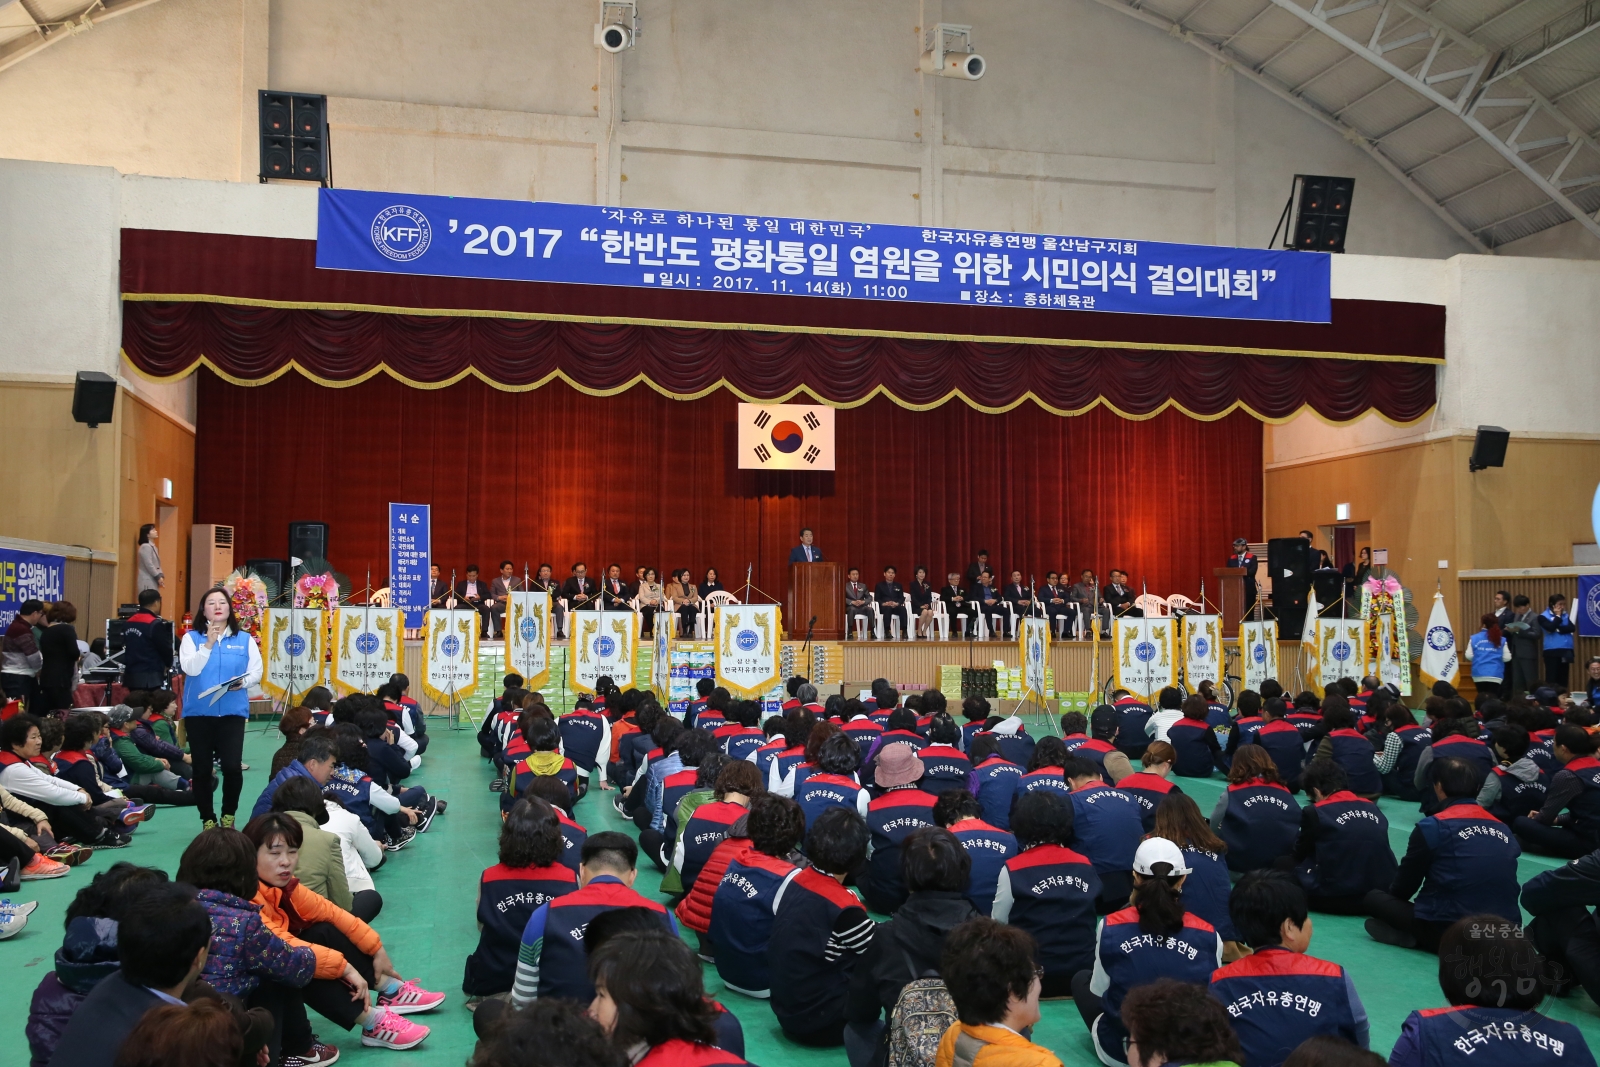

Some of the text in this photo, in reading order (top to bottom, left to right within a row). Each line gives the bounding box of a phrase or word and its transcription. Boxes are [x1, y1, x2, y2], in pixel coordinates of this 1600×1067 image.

[676, 213, 734, 231] 하나된
[743, 217, 780, 234] 통일
[383, 226, 420, 242] KFF
[921, 229, 1138, 256] 한국자유총연맹 울산남구지회
[380, 244, 408, 259] FREEDOM
[710, 236, 839, 279] 평화통일
[849, 244, 943, 284] 염원을
[953, 253, 1013, 286] 위한
[1021, 256, 1139, 295] 시민의식
[659, 272, 690, 288] 일시
[713, 275, 759, 291] 2017.
[771, 279, 793, 293] 11.
[805, 281, 852, 297] 14(화)
[863, 283, 908, 299] 11:00
[974, 289, 1002, 305] 장소
[1023, 292, 1096, 309] 종하체육관
[724, 666, 770, 674] 한국자유총연맹
[1026, 777, 1070, 792] 한국자유총연맹
[804, 788, 845, 803] 한국자유총연맹
[1085, 789, 1130, 804] 한국자유총연맹
[1243, 794, 1289, 811] 한국자유총연맹
[1336, 809, 1379, 826] 한국자유총연맹
[1457, 824, 1510, 844] 한국자유총연맹
[1031, 874, 1090, 896] 한국자유총연맹
[1226, 989, 1323, 1018] 한국자유총연맹
[1453, 1021, 1566, 1057] 한국자유총연맹
